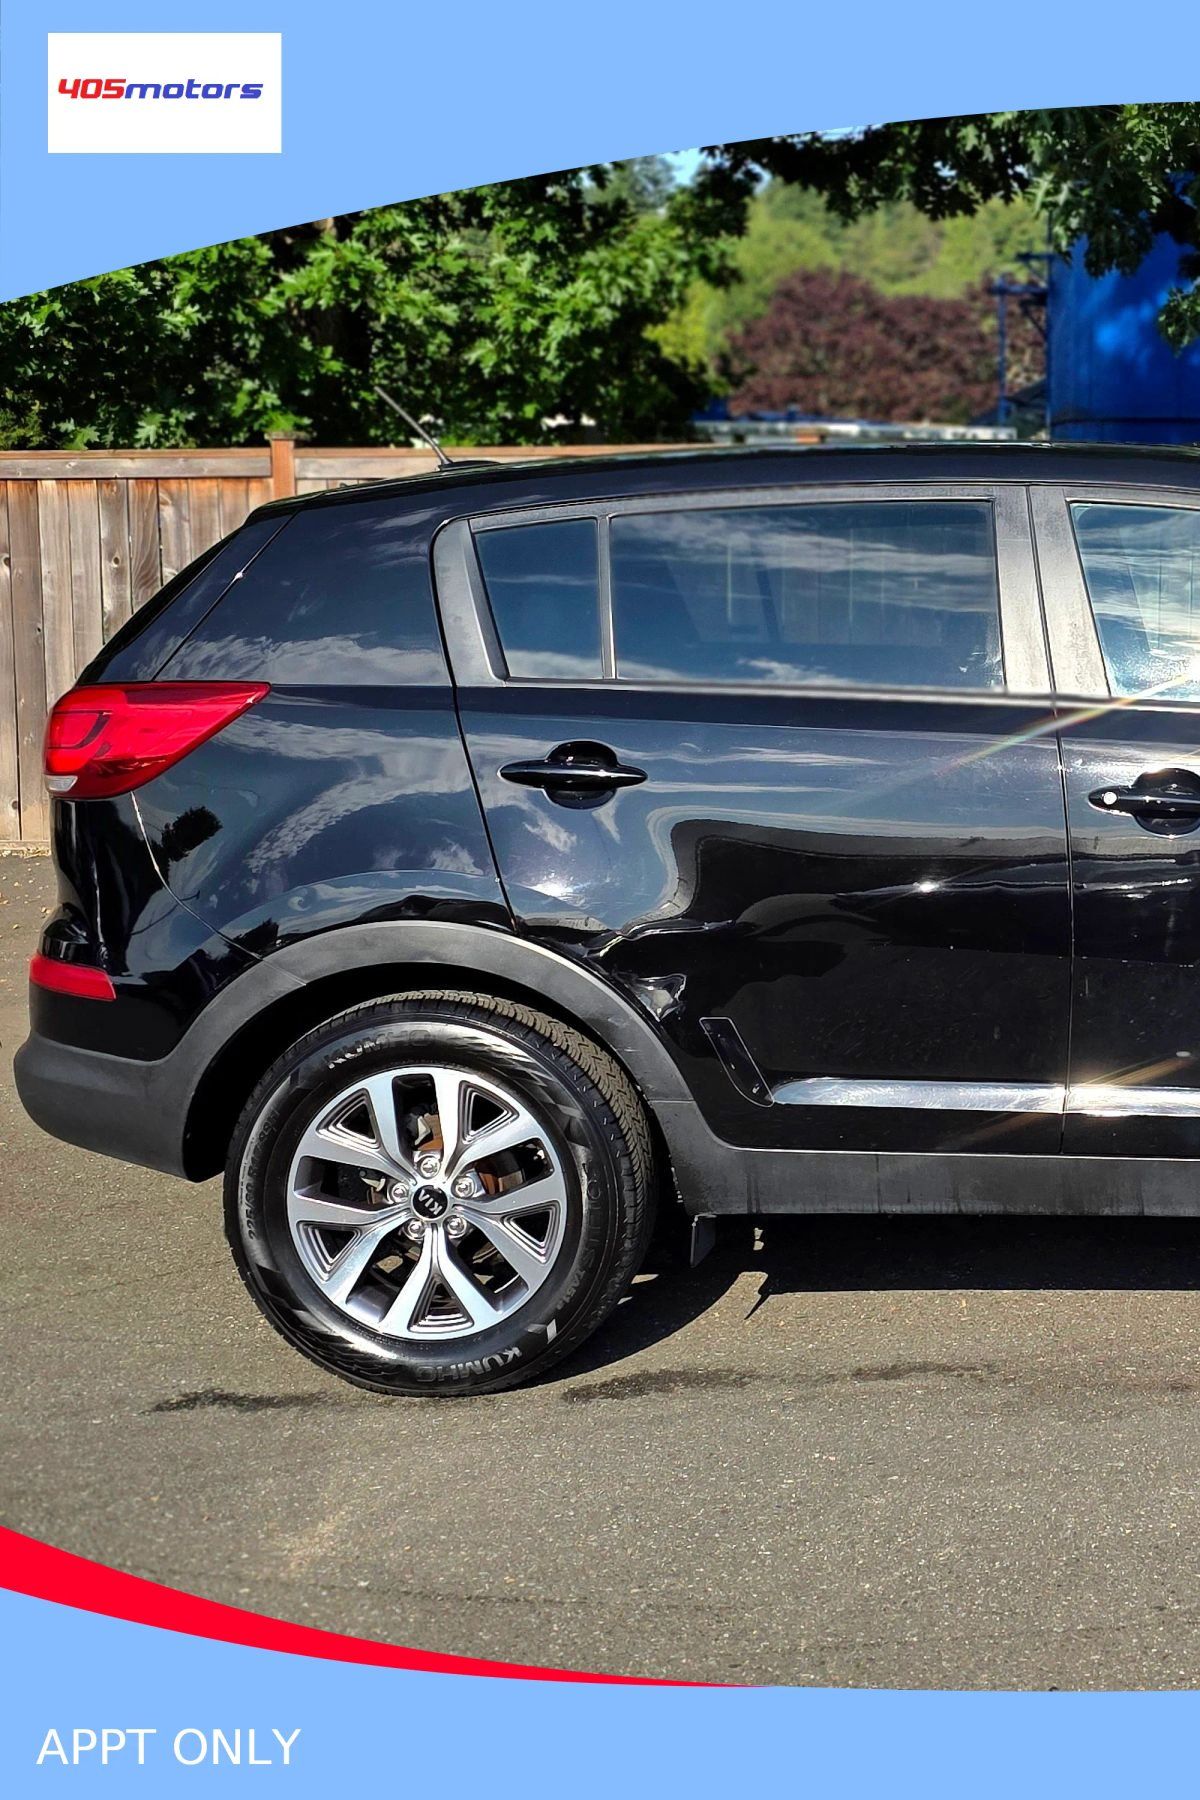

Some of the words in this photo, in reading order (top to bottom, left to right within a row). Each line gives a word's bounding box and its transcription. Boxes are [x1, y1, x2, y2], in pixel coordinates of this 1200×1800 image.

[324, 1029, 432, 1069] KUMHO
[419, 1189, 443, 1216] KIA
[416, 1346, 523, 1383] KUMHO
